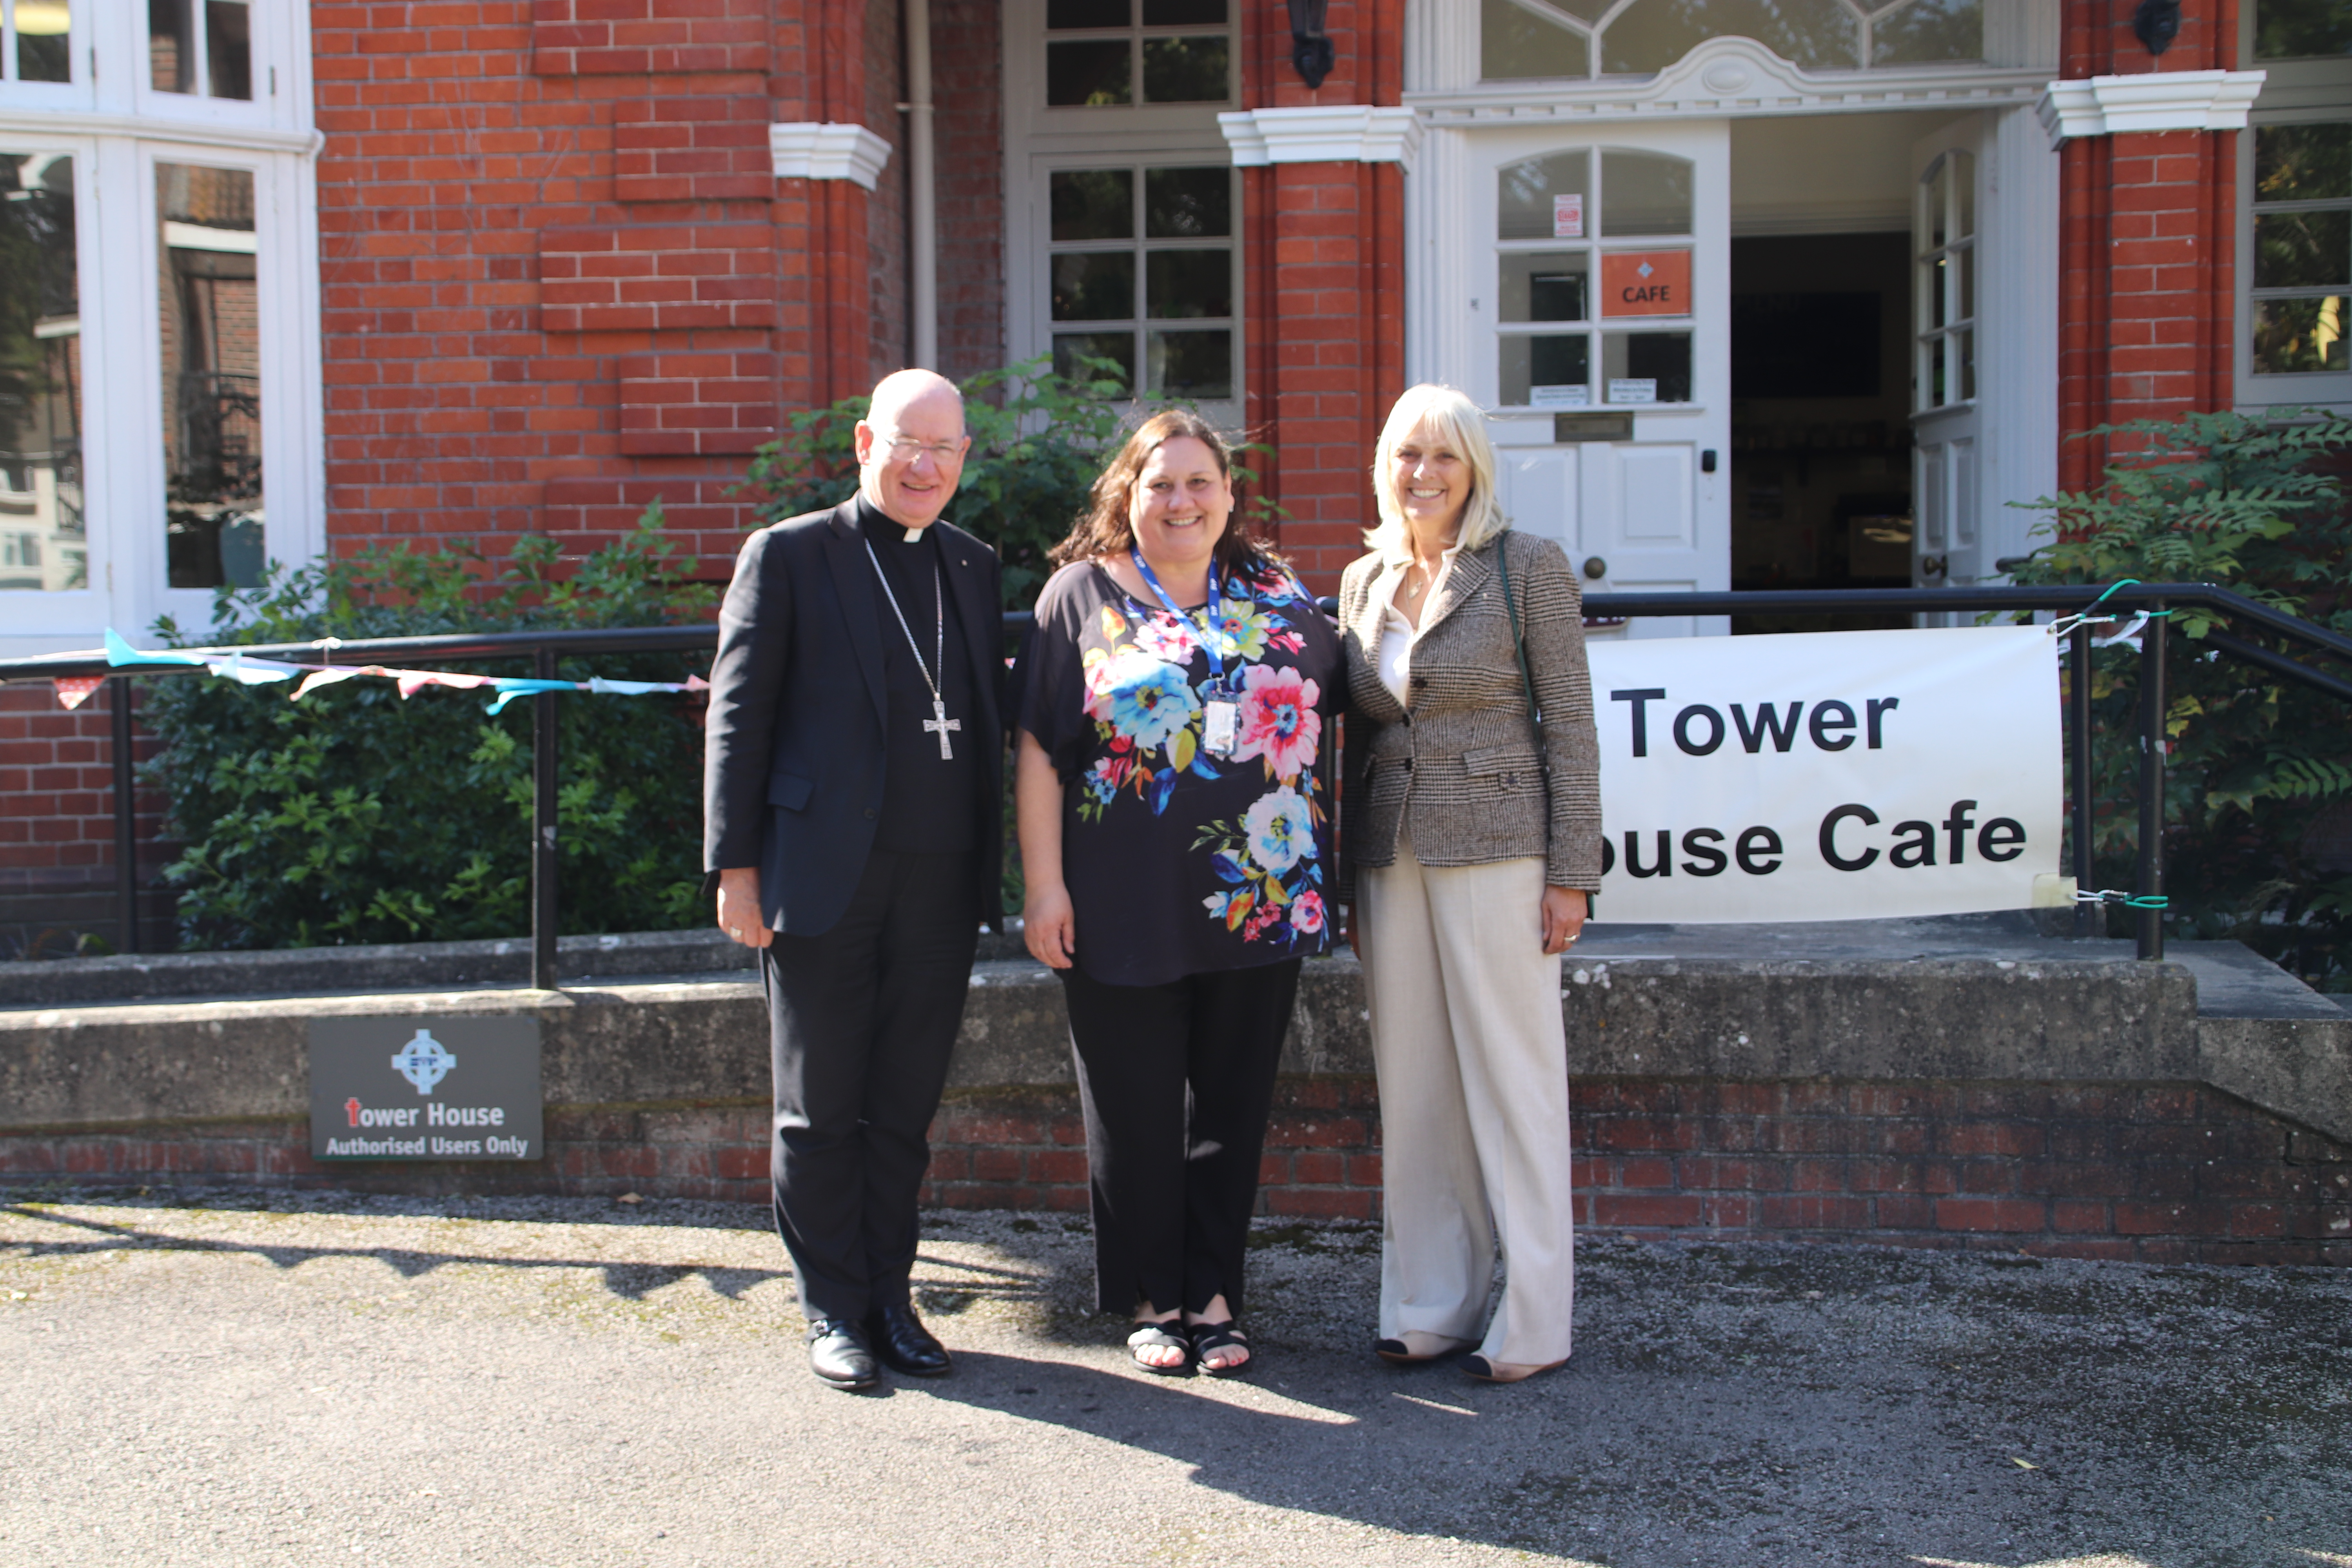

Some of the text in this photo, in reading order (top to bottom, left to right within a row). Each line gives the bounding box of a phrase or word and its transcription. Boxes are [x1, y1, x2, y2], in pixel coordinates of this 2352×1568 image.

[1622, 285, 1670, 303] CAFE
[1611, 688, 1899, 757] Tower
[1602, 800, 2027, 879] use Cafe
[427, 1102, 504, 1127] House
[326, 1135, 528, 1158] Authorised Users Only
